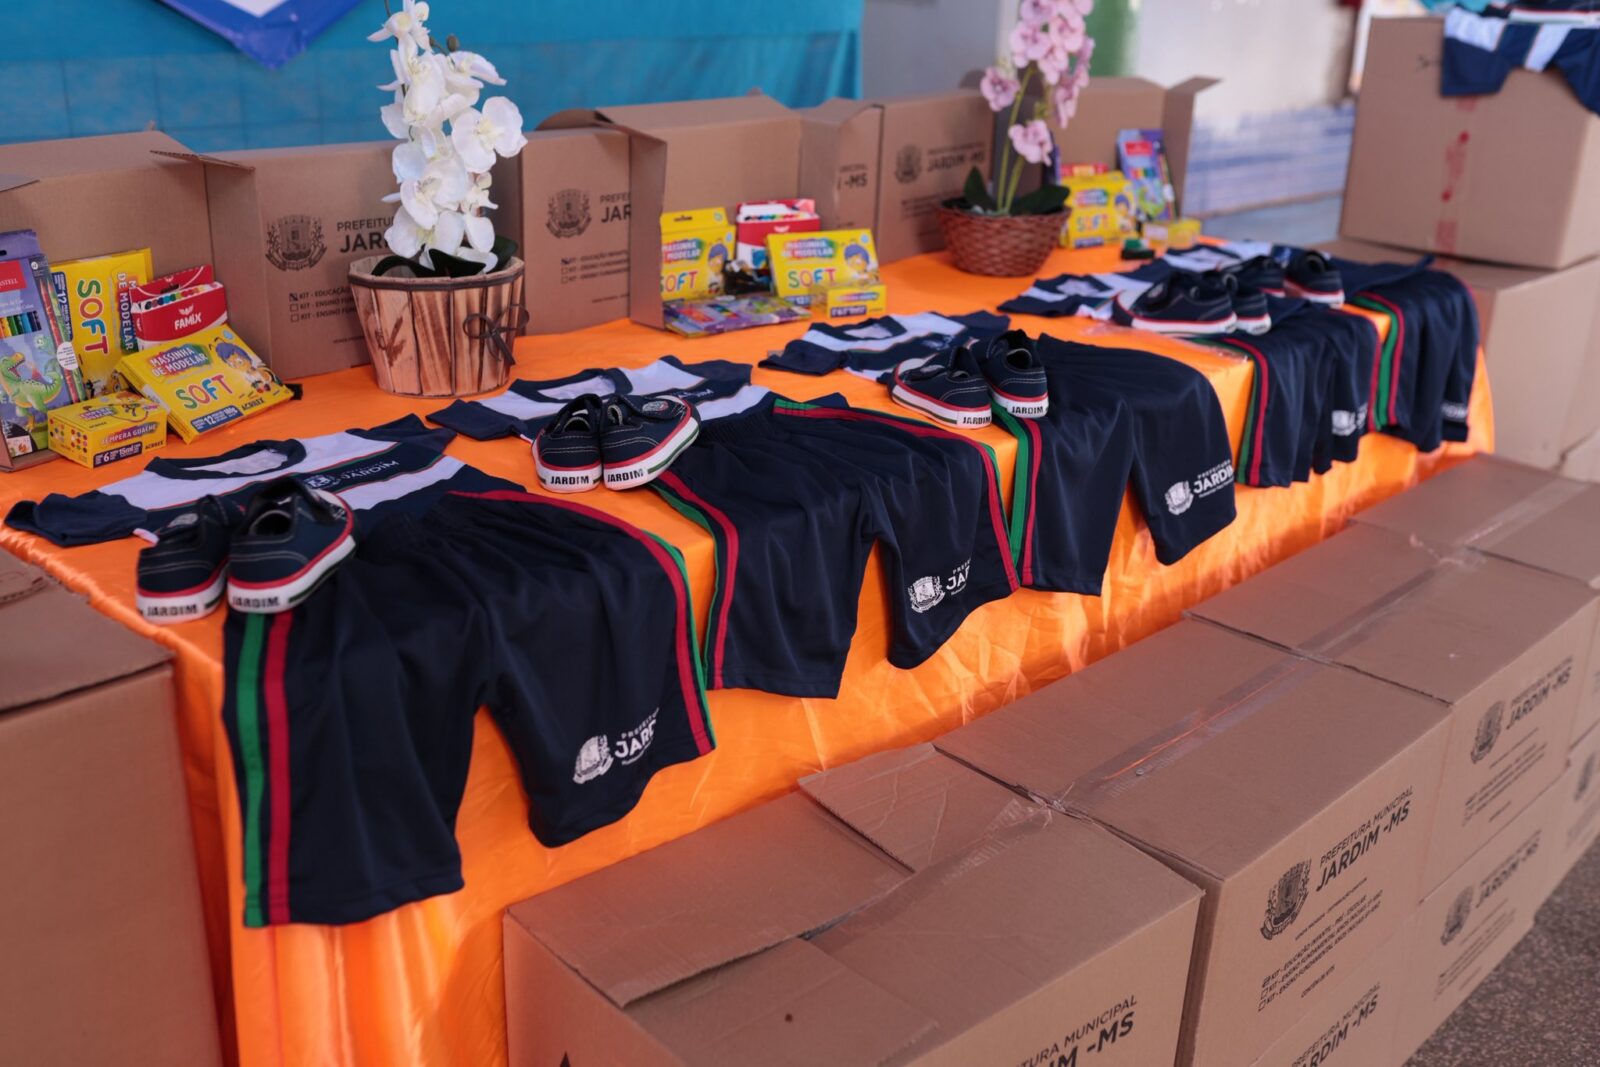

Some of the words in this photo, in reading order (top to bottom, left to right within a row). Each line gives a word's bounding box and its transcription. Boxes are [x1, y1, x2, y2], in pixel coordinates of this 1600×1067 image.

[117, 273, 128, 289] DE
[788, 268, 837, 289] SOFT
[77, 278, 110, 355] SOFT
[119, 292, 135, 351] MODELAR
[150, 347, 195, 368] MASSINHA
[151, 365, 166, 377] DE
[167, 353, 208, 373] MODELAR
[175, 373, 234, 410] SOFT
[203, 415, 216, 426] 12
[1012, 406, 1044, 415] JARDIM
[103, 452, 110, 462] 6
[549, 475, 590, 485] JARDIM
[607, 468, 644, 483] JARDIM
[147, 604, 198, 617] JARDIM
[232, 596, 280, 608] JARDIM
[1316, 825, 1381, 892] JARDIM
[1383, 800, 1411, 833] -MS
[1320, 820, 1371, 868] PREFEITURA
[1063, 994, 1138, 1049] MUNICIPAL
[1086, 1011, 1135, 1053] -MS
[1303, 1022, 1349, 1067] RDIM
